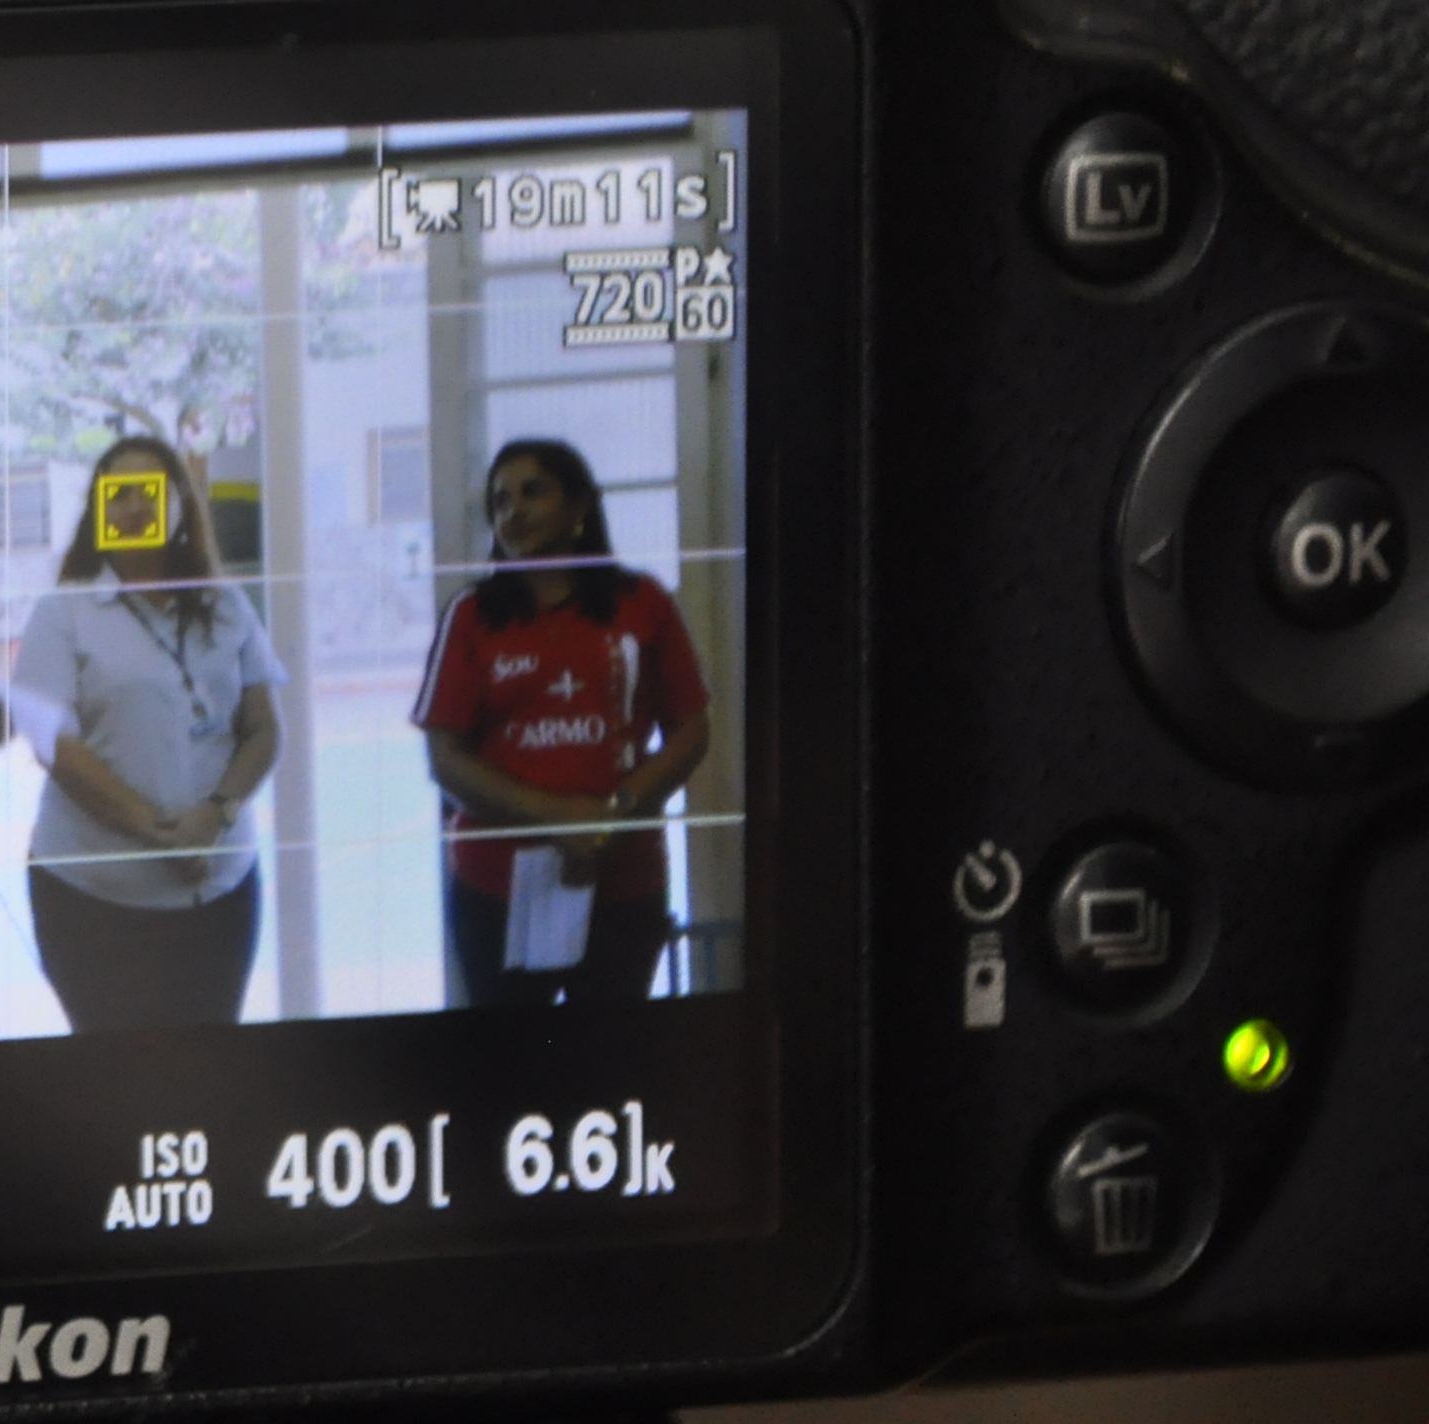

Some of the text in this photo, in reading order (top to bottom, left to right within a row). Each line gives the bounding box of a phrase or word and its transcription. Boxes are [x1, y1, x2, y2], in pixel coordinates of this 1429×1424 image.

[571, 274, 666, 326] 720
[682, 290, 729, 333] 60
[1290, 519, 1391, 590] OK
[141, 1130, 209, 1178] ISO
[104, 1181, 214, 1232] AUTO
